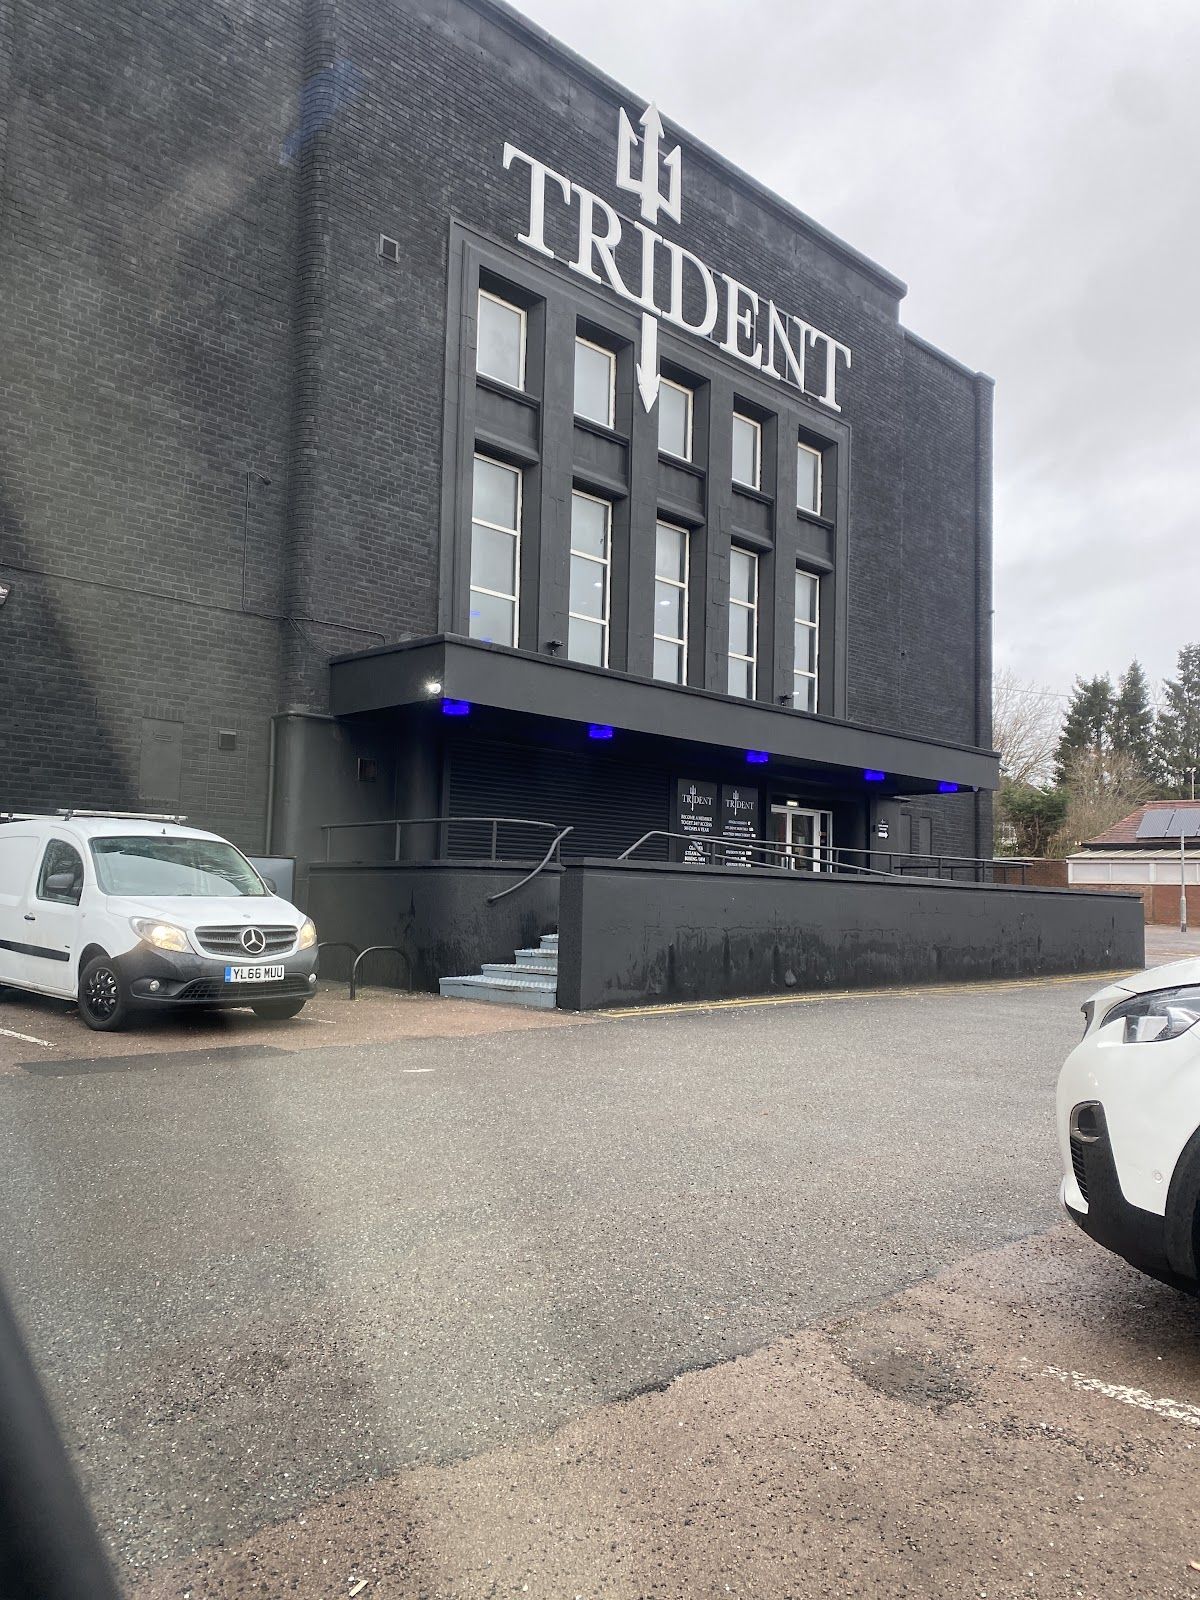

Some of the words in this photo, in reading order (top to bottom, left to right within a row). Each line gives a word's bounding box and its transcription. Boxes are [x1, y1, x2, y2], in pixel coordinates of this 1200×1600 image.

[502, 141, 851, 412] TRIDENT
[682, 794, 713, 806] TRIDENT
[725, 799, 754, 810] TRIDENT
[233, 968, 261, 980] YL66
[263, 966, 283, 979] MUU
